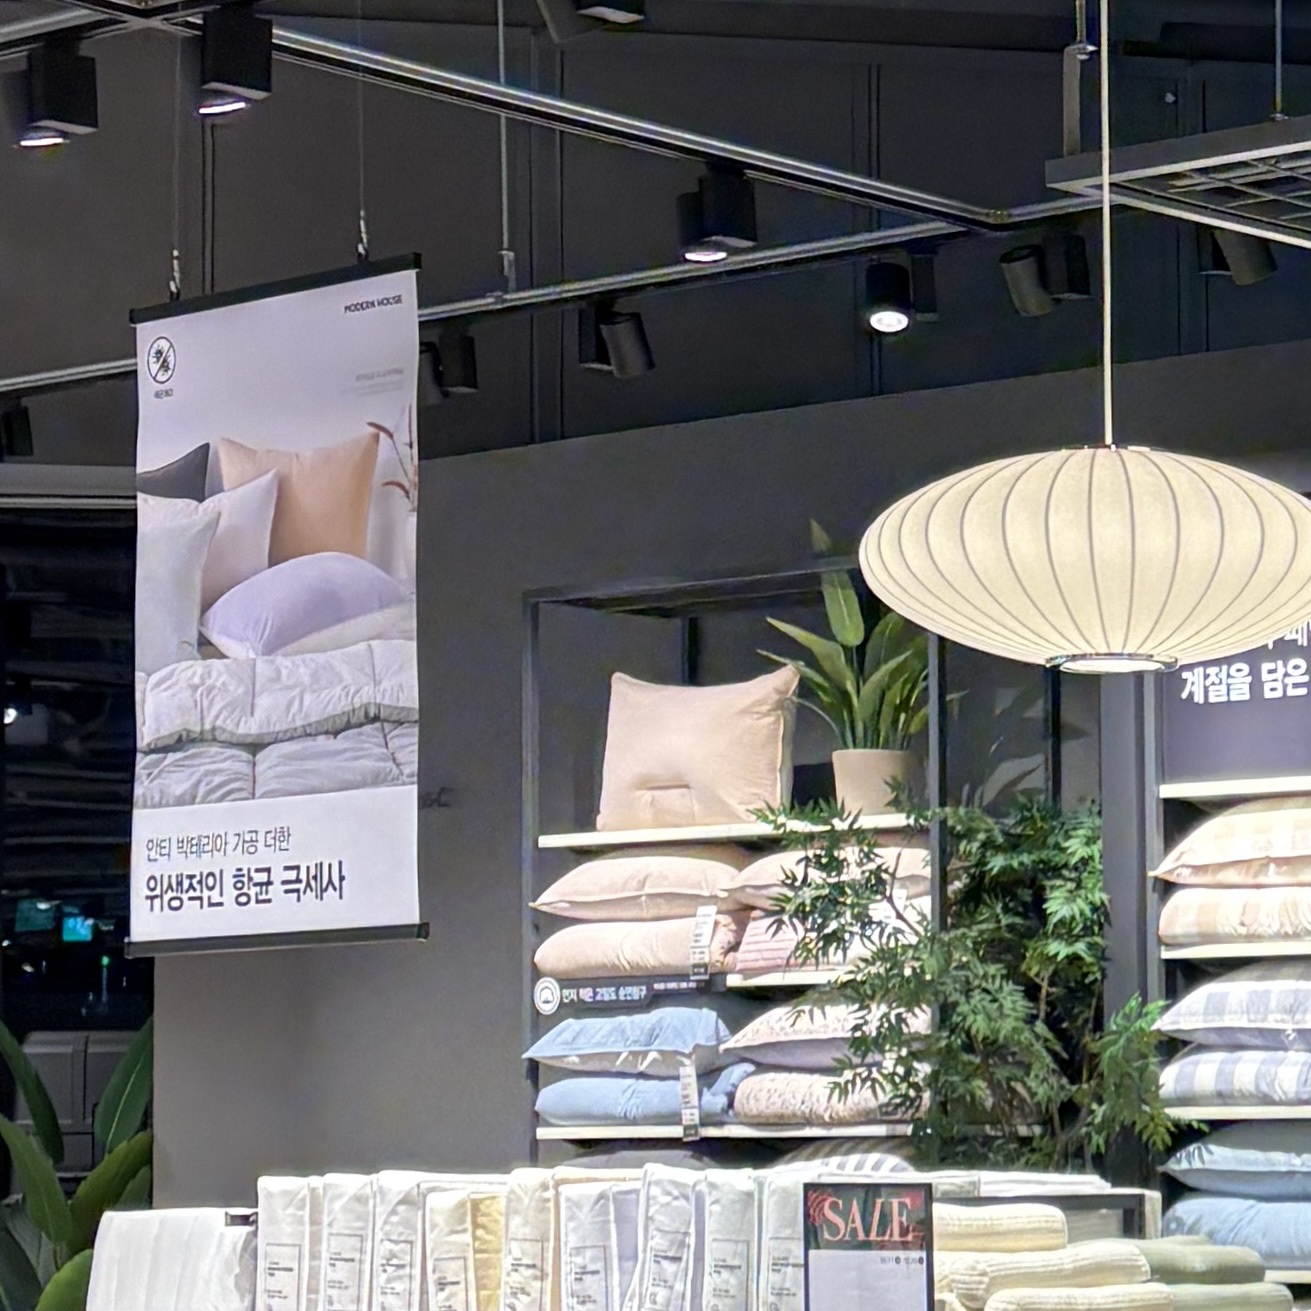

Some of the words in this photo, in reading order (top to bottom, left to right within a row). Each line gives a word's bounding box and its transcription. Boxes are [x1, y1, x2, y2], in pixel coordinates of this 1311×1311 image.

[1180, 661, 1252, 704] 계절을
[1261, 658, 1310, 699] 담은
[146, 837, 171, 862] 안티
[177, 832, 229, 859] 박테리아
[232, 829, 259, 855] 가공
[264, 826, 291, 852] 더한
[145, 868, 225, 912] 위생적인
[232, 866, 274, 907] 항균
[280, 860, 346, 903] 극세사
[823, 1197, 913, 1242] SALE
